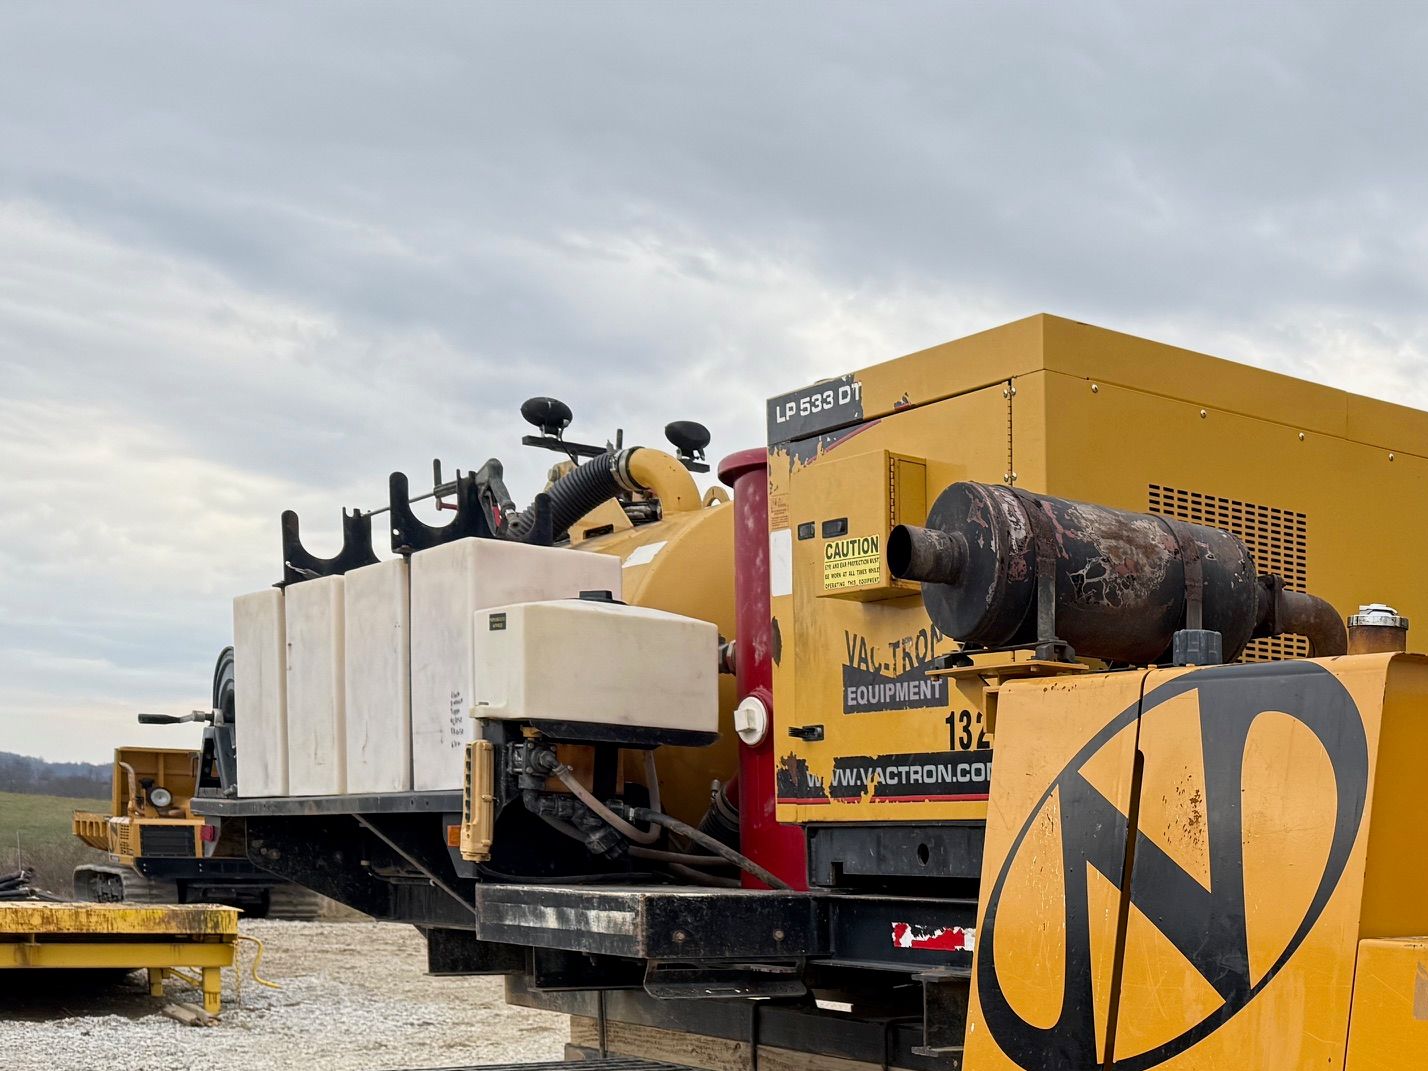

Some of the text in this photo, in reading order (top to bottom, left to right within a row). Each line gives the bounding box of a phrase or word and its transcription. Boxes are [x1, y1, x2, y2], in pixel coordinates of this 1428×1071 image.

[776, 381, 862, 424] LP 533 DT
[825, 535, 879, 560] CAUTION
[847, 679, 943, 706] EQUIPMENT
[945, 709, 990, 751] 132
